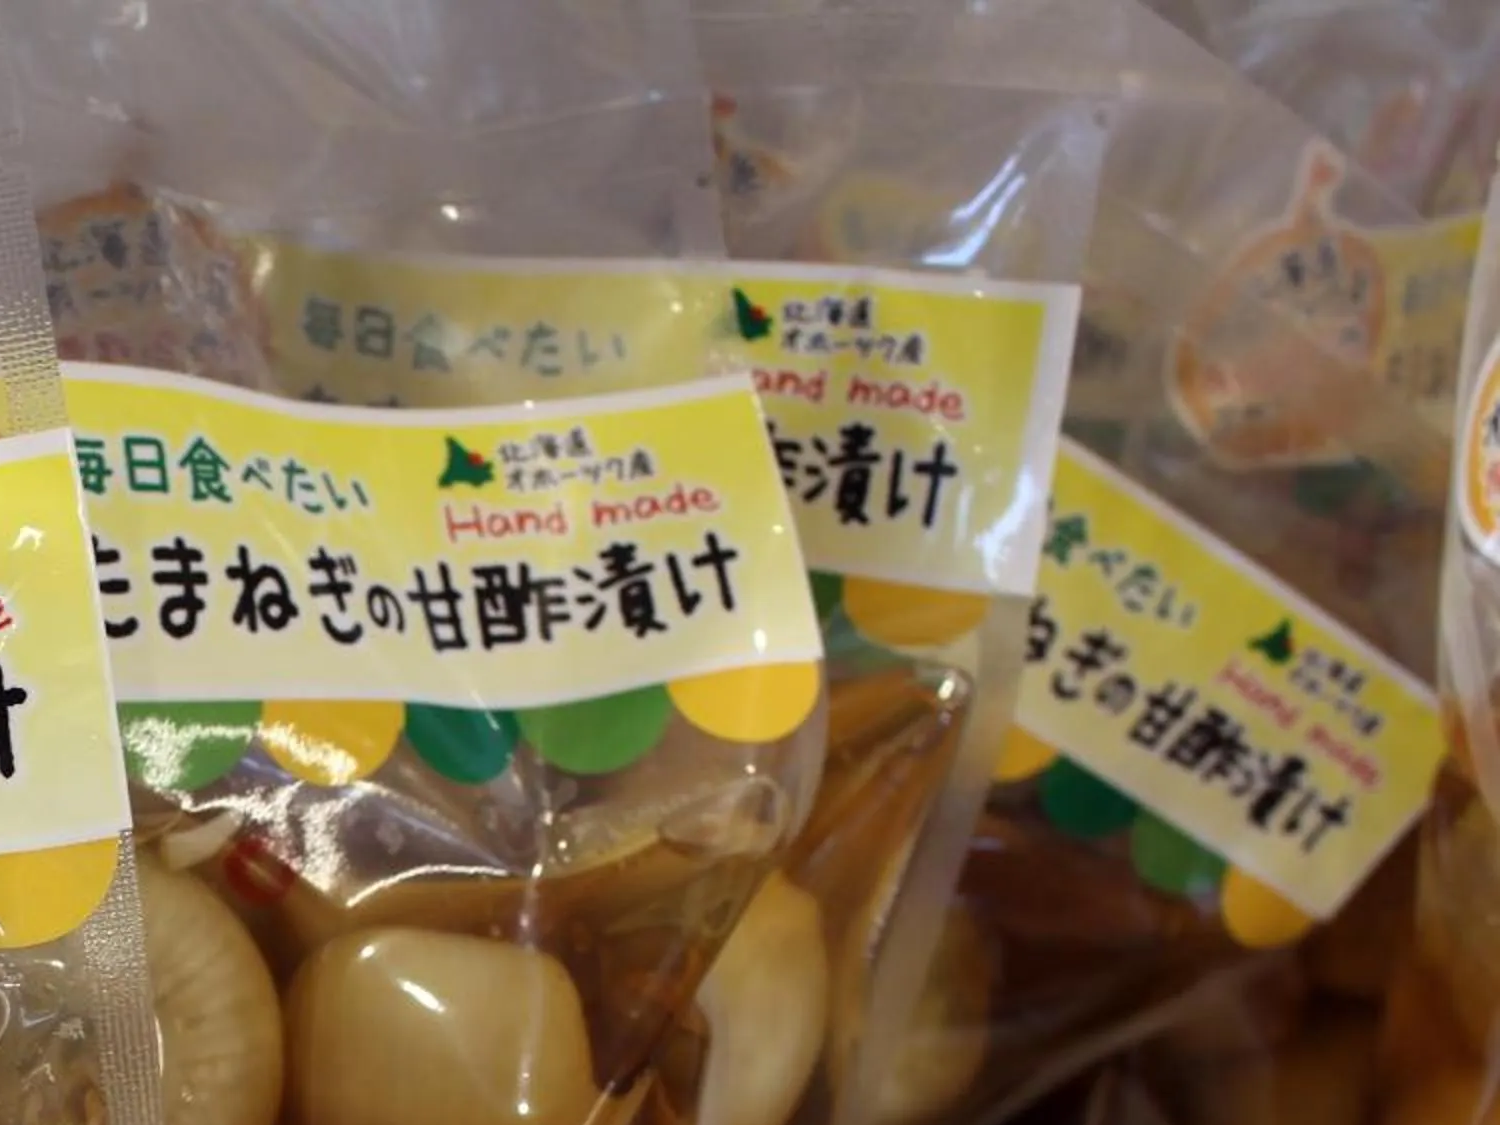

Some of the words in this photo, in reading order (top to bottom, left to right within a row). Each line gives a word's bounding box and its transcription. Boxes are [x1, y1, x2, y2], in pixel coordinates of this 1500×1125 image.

[848, 376, 964, 421] made
[445, 505, 567, 544] Hand
[592, 484, 720, 527] made
